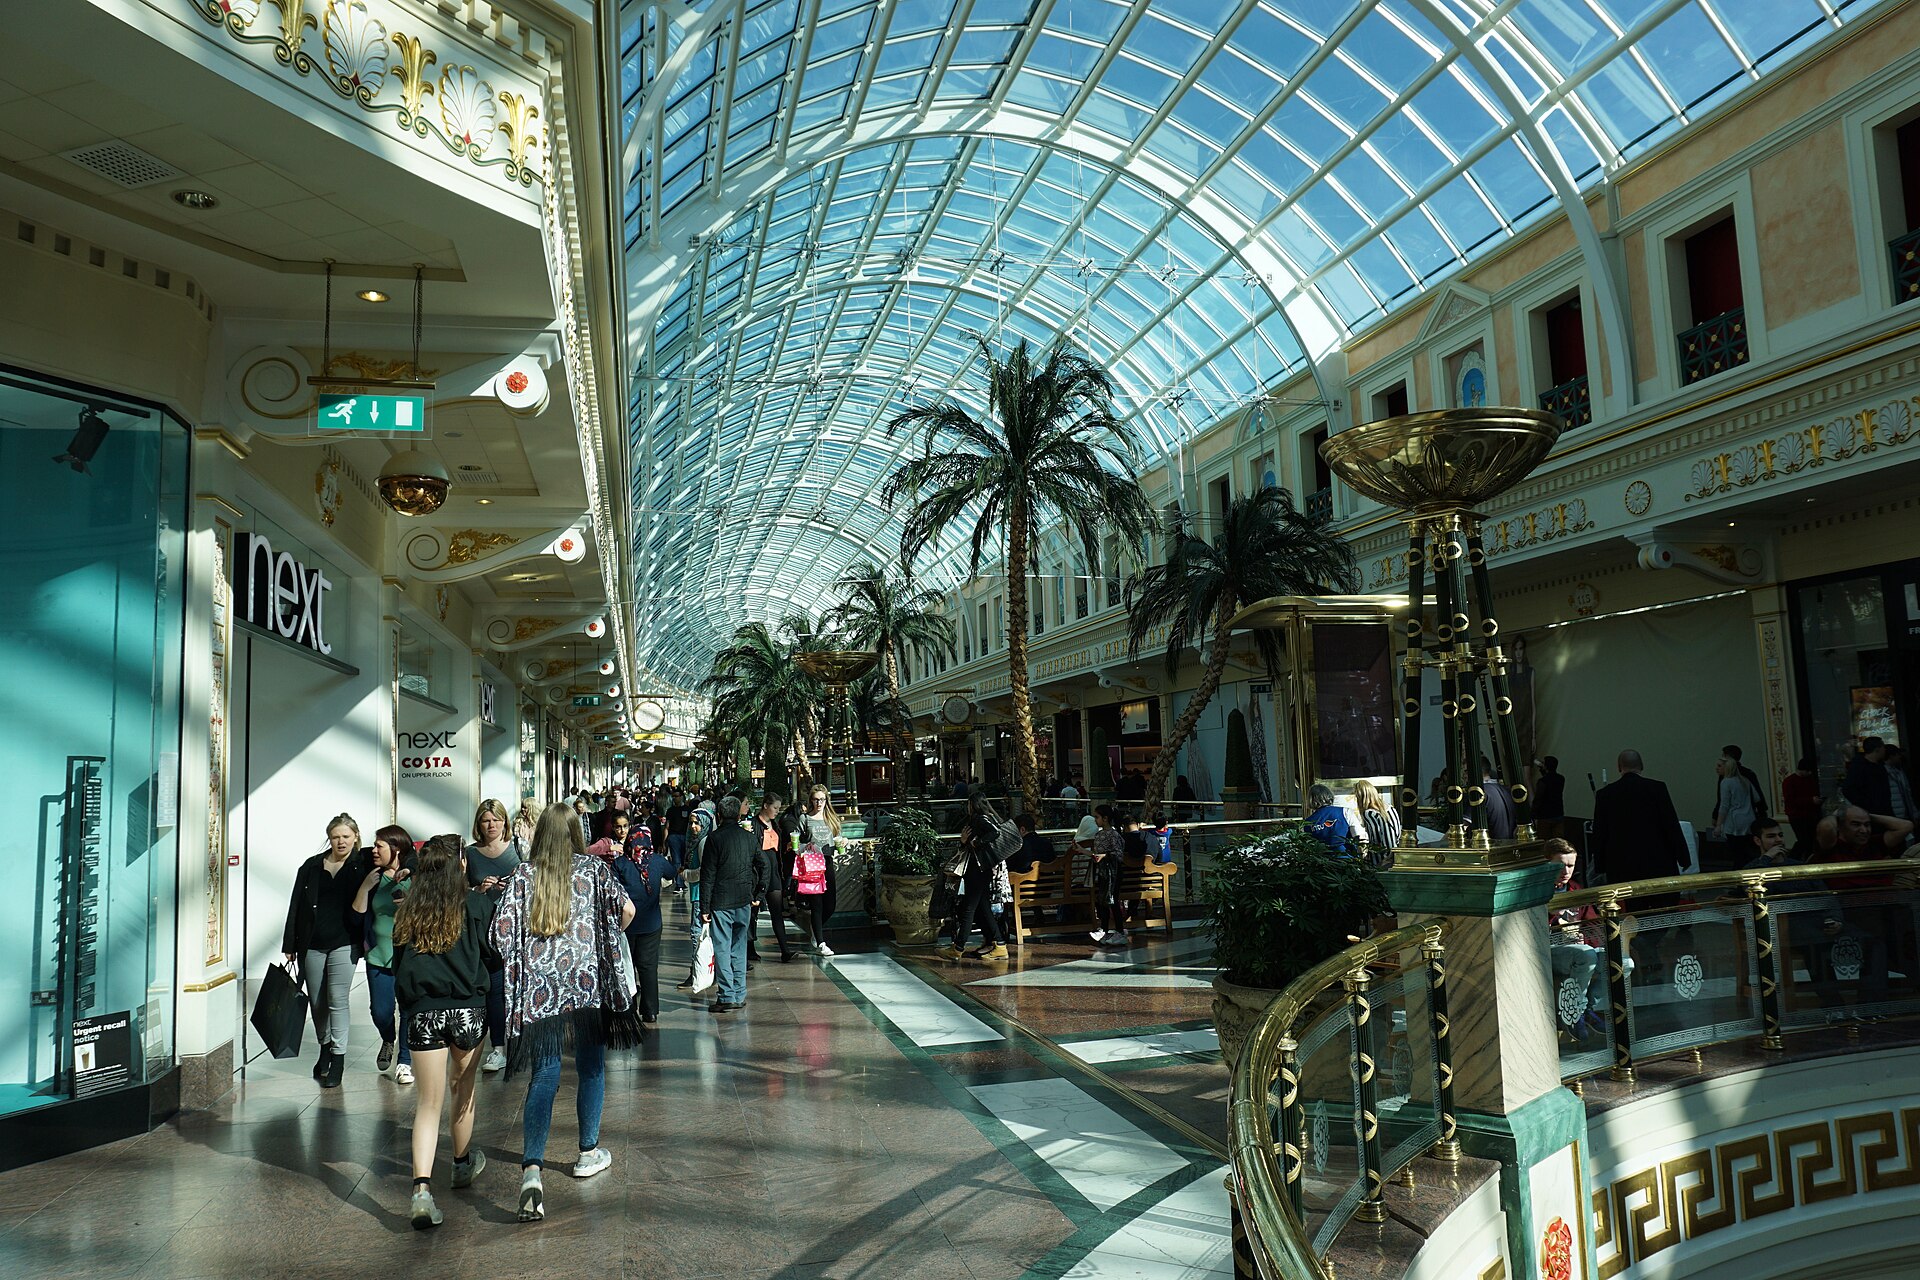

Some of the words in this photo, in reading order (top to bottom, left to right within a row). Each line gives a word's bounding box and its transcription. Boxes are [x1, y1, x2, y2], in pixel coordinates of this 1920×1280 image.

[247, 533, 332, 655] next
[397, 731, 456, 749] next
[401, 756, 452, 770] COSTA
[73, 1025, 102, 1036] Urgent
[103, 1019, 126, 1031] recall
[74, 1034, 100, 1044] notice
